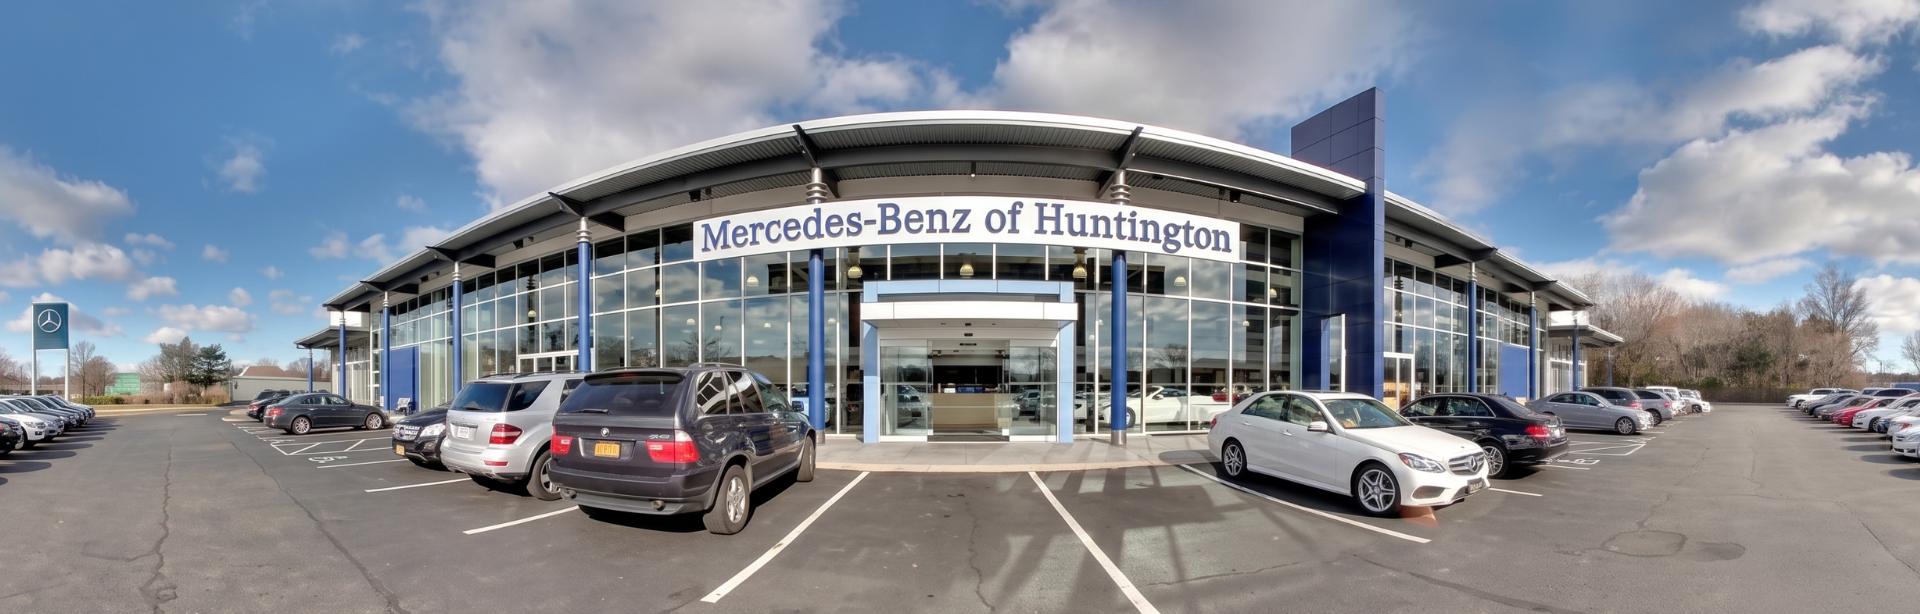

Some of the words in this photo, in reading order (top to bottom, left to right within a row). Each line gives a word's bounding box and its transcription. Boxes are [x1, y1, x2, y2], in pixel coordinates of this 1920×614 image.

[701, 202, 972, 252] Mercedes-Benz
[984, 201, 1023, 234] of
[1034, 202, 1233, 254] Huntington
